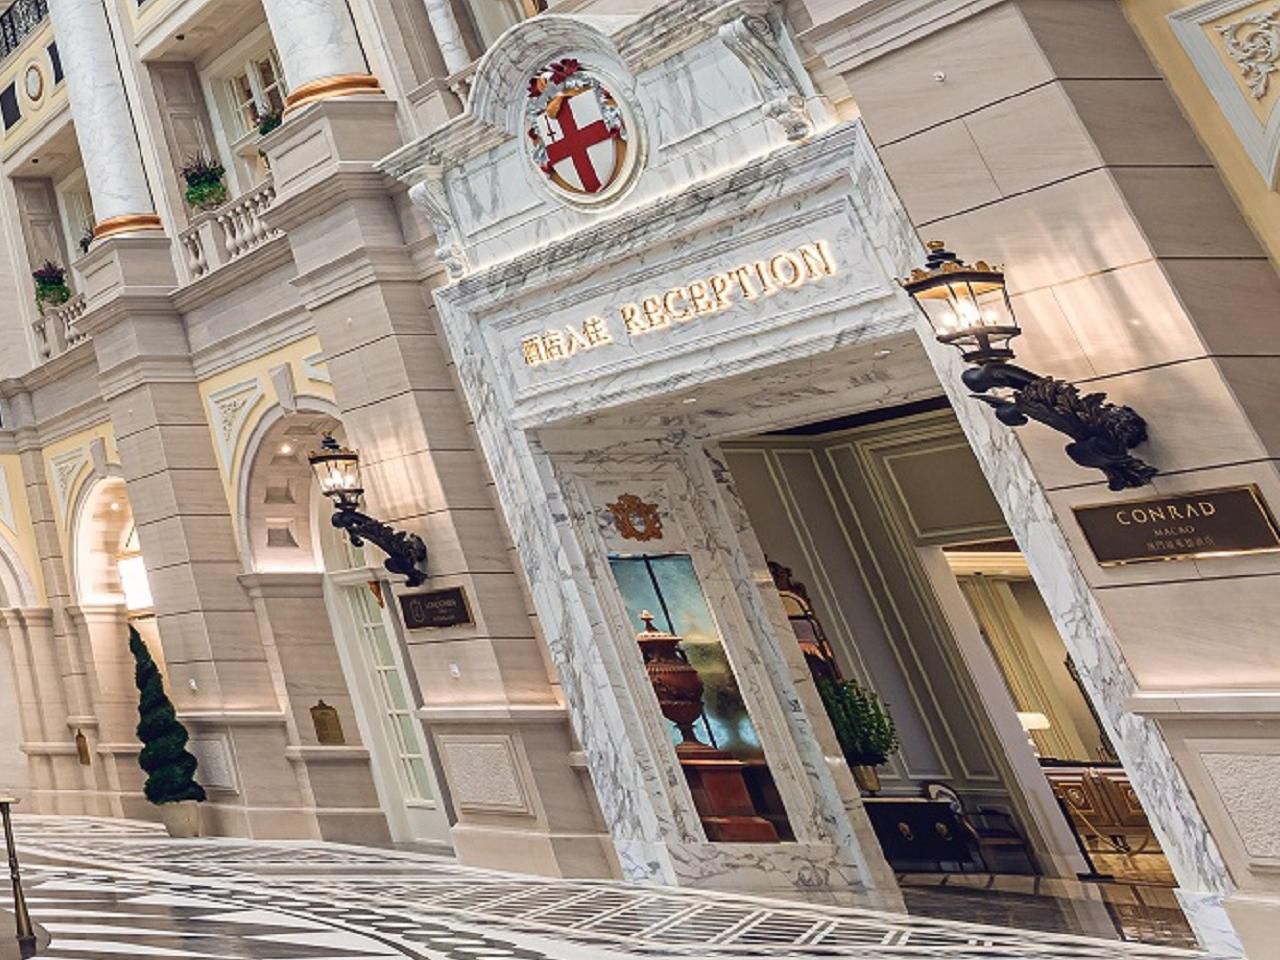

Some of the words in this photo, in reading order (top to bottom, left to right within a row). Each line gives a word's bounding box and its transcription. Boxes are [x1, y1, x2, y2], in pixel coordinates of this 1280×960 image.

[523, 316, 611, 366] 酒店入住
[619, 241, 835, 336] RECEPTION
[1116, 502, 1216, 525] CONRAD
